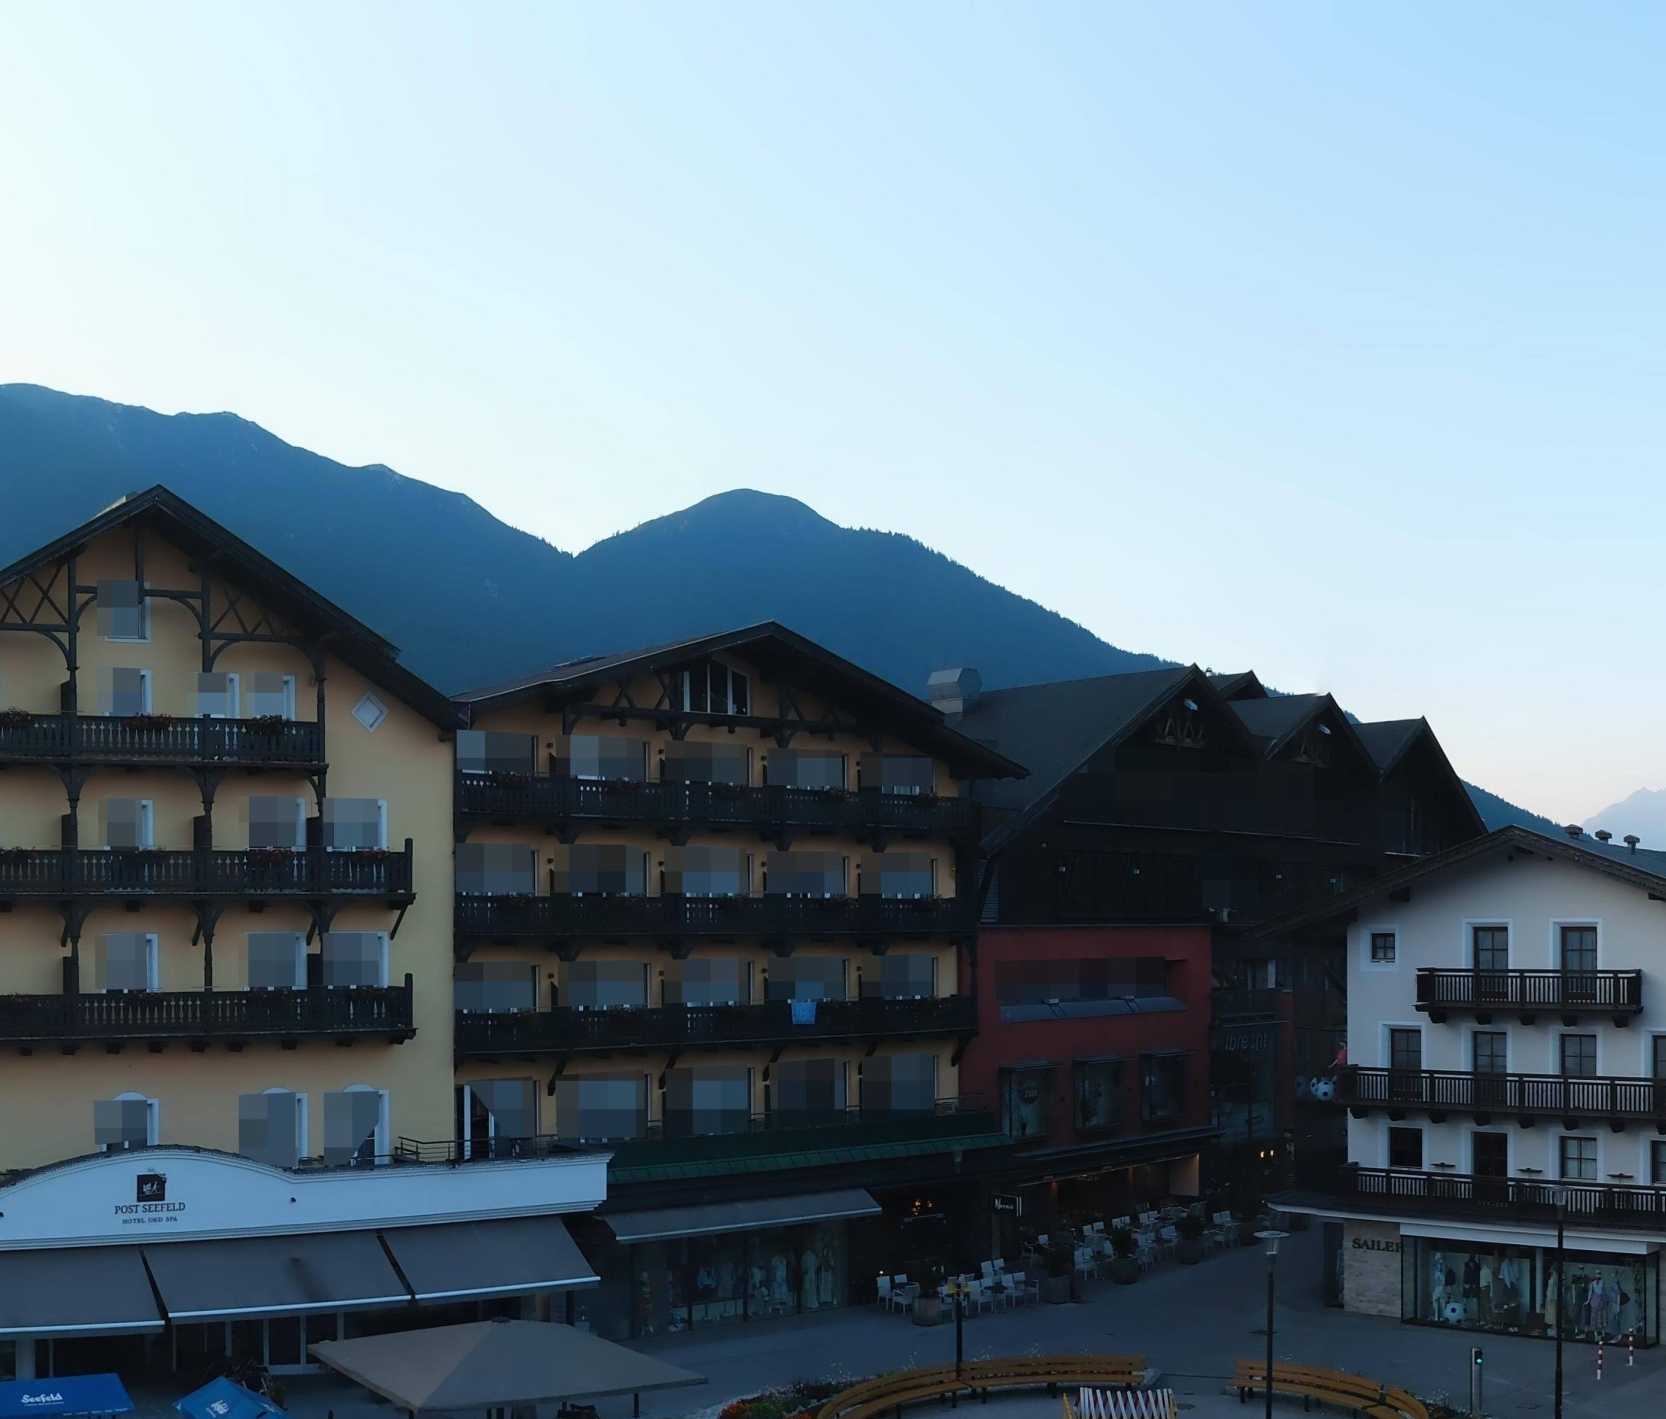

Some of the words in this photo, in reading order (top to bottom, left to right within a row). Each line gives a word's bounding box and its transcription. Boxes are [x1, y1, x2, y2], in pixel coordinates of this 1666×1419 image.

[114, 1204, 140, 1214] POST
[141, 1202, 186, 1213] SEEFELD
[1352, 1239, 1405, 1254] SAILER
[21, 1391, 63, 1404] Seefeld
